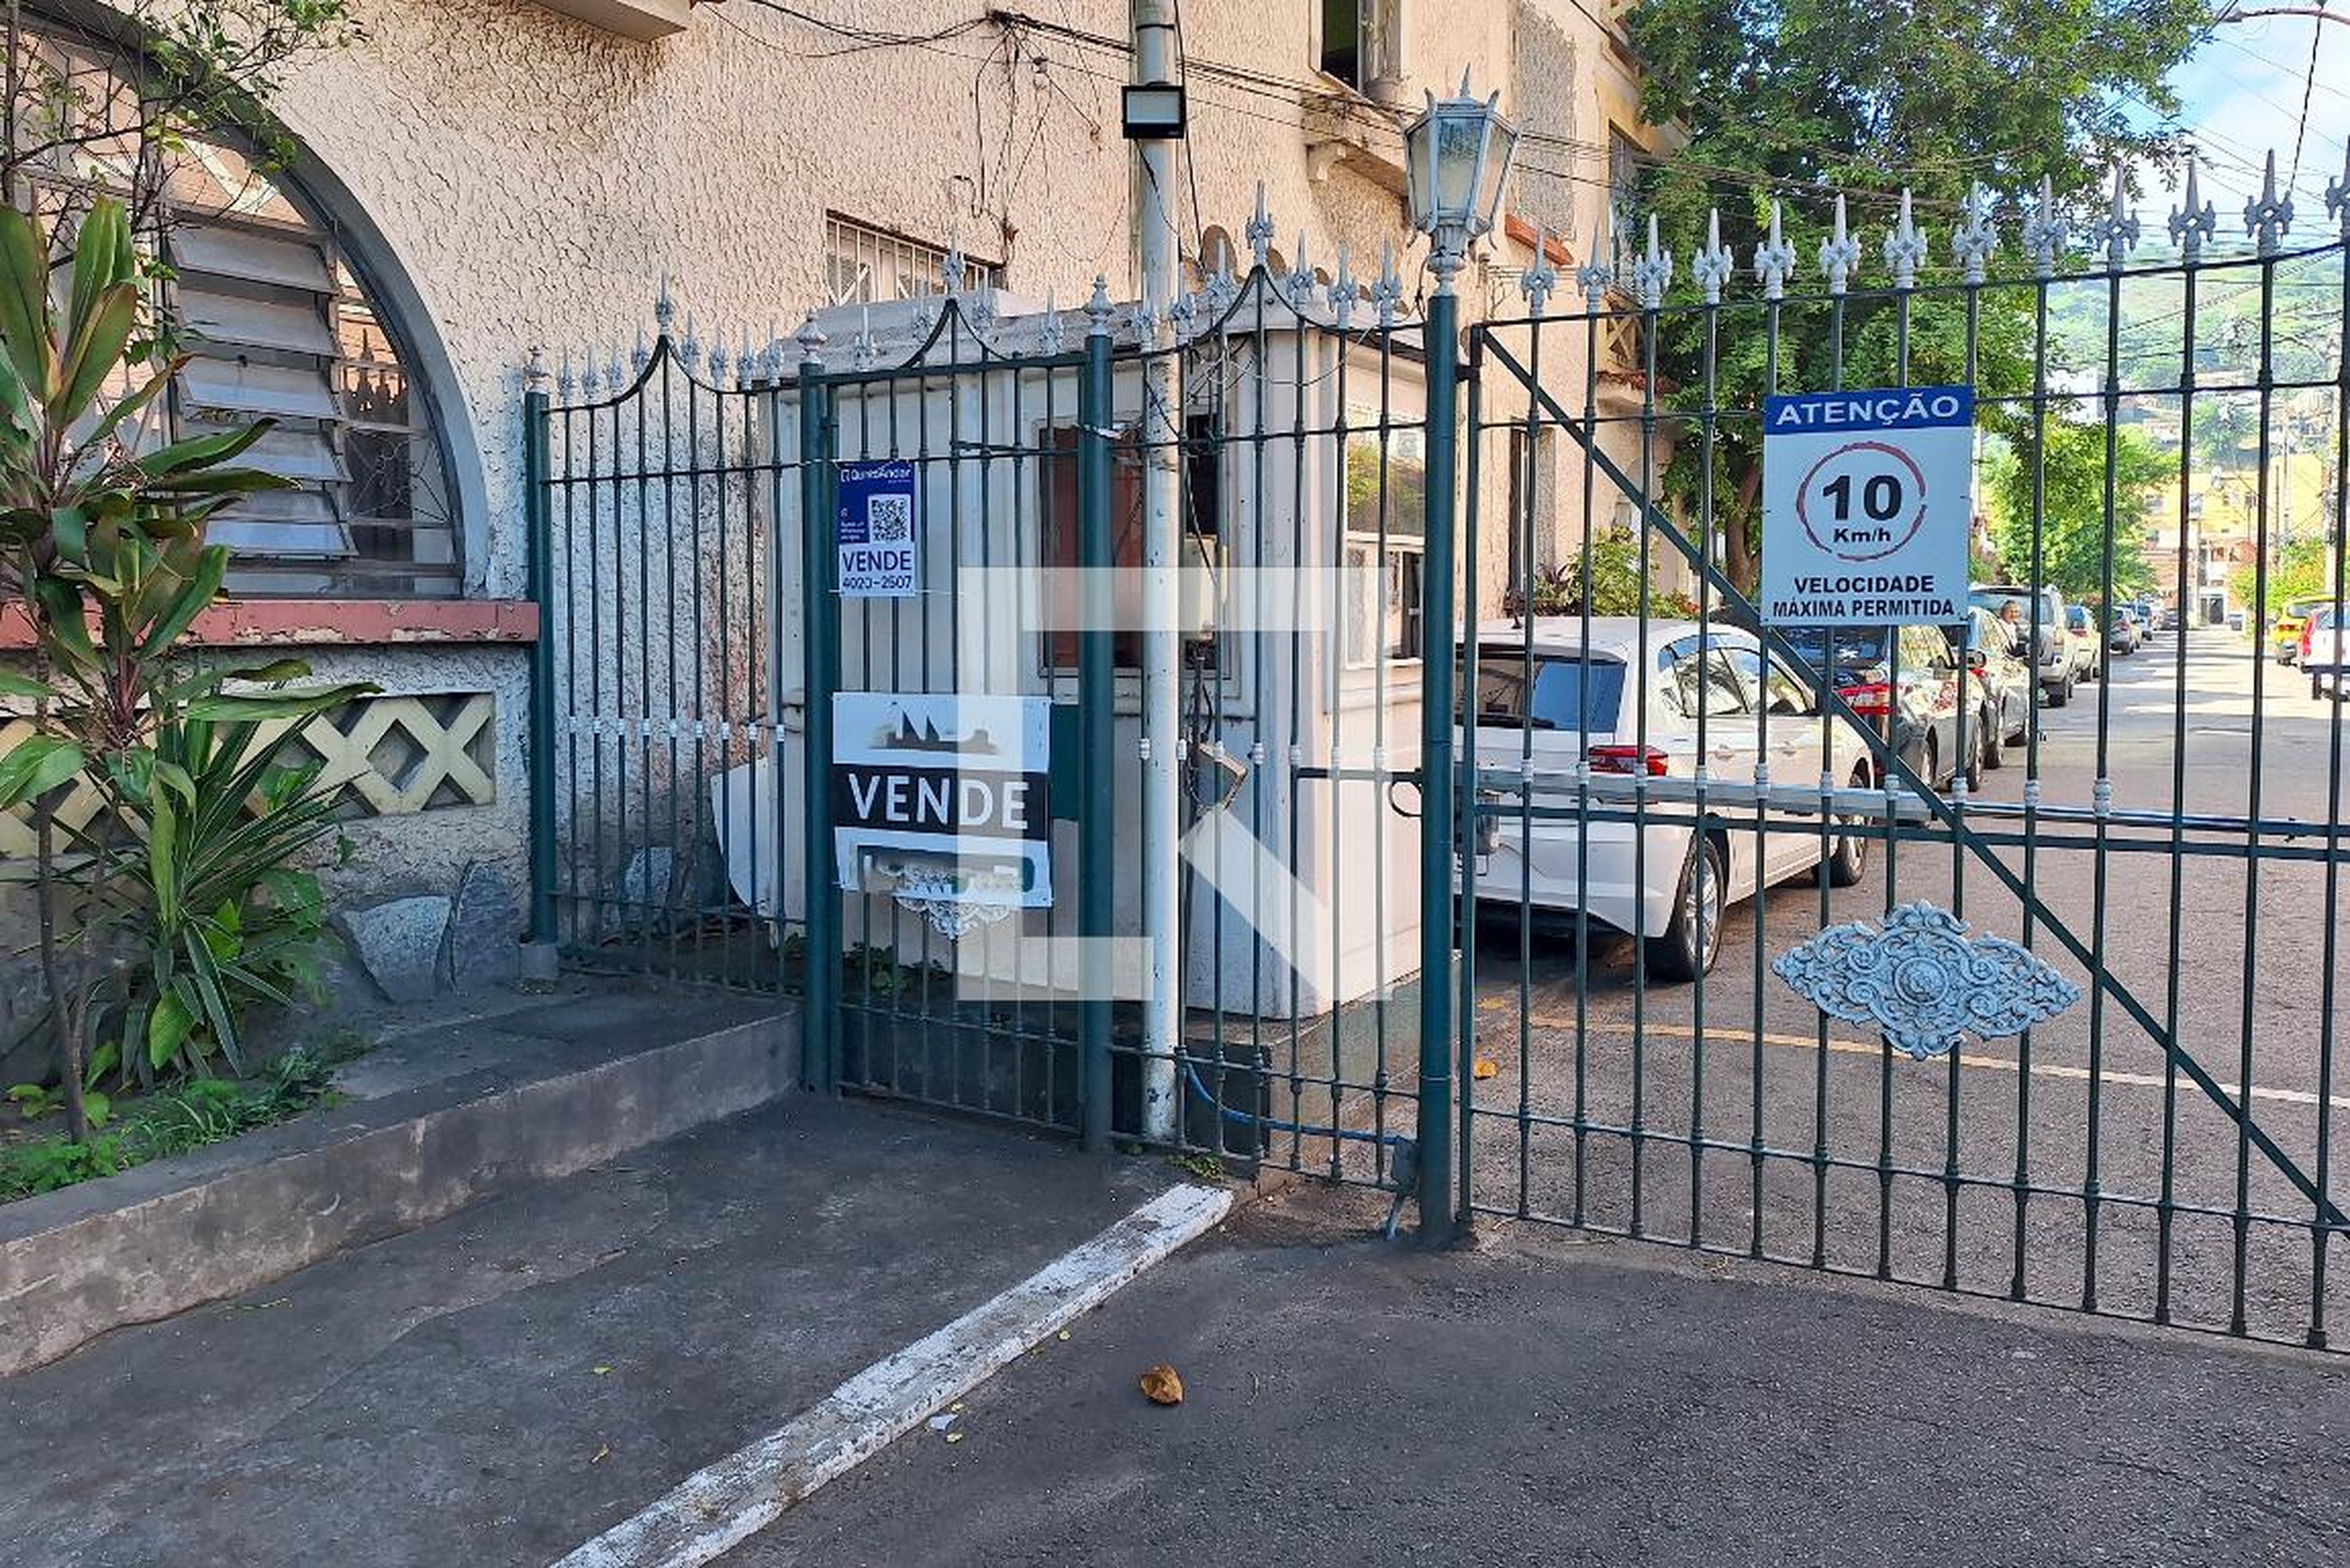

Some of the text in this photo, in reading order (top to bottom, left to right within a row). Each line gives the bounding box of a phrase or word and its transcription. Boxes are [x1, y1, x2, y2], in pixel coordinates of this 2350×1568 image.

[1775, 393, 1959, 425] ATENÇÃO
[1822, 474, 1902, 521] 10
[1833, 528, 1892, 543] Km/h
[842, 551, 912, 572] VENDE
[1794, 576, 1934, 594] VELOCIDADE
[1773, 597, 1954, 617] MÁXIMA PERMITIDA
[848, 773, 1029, 829] VENDE
